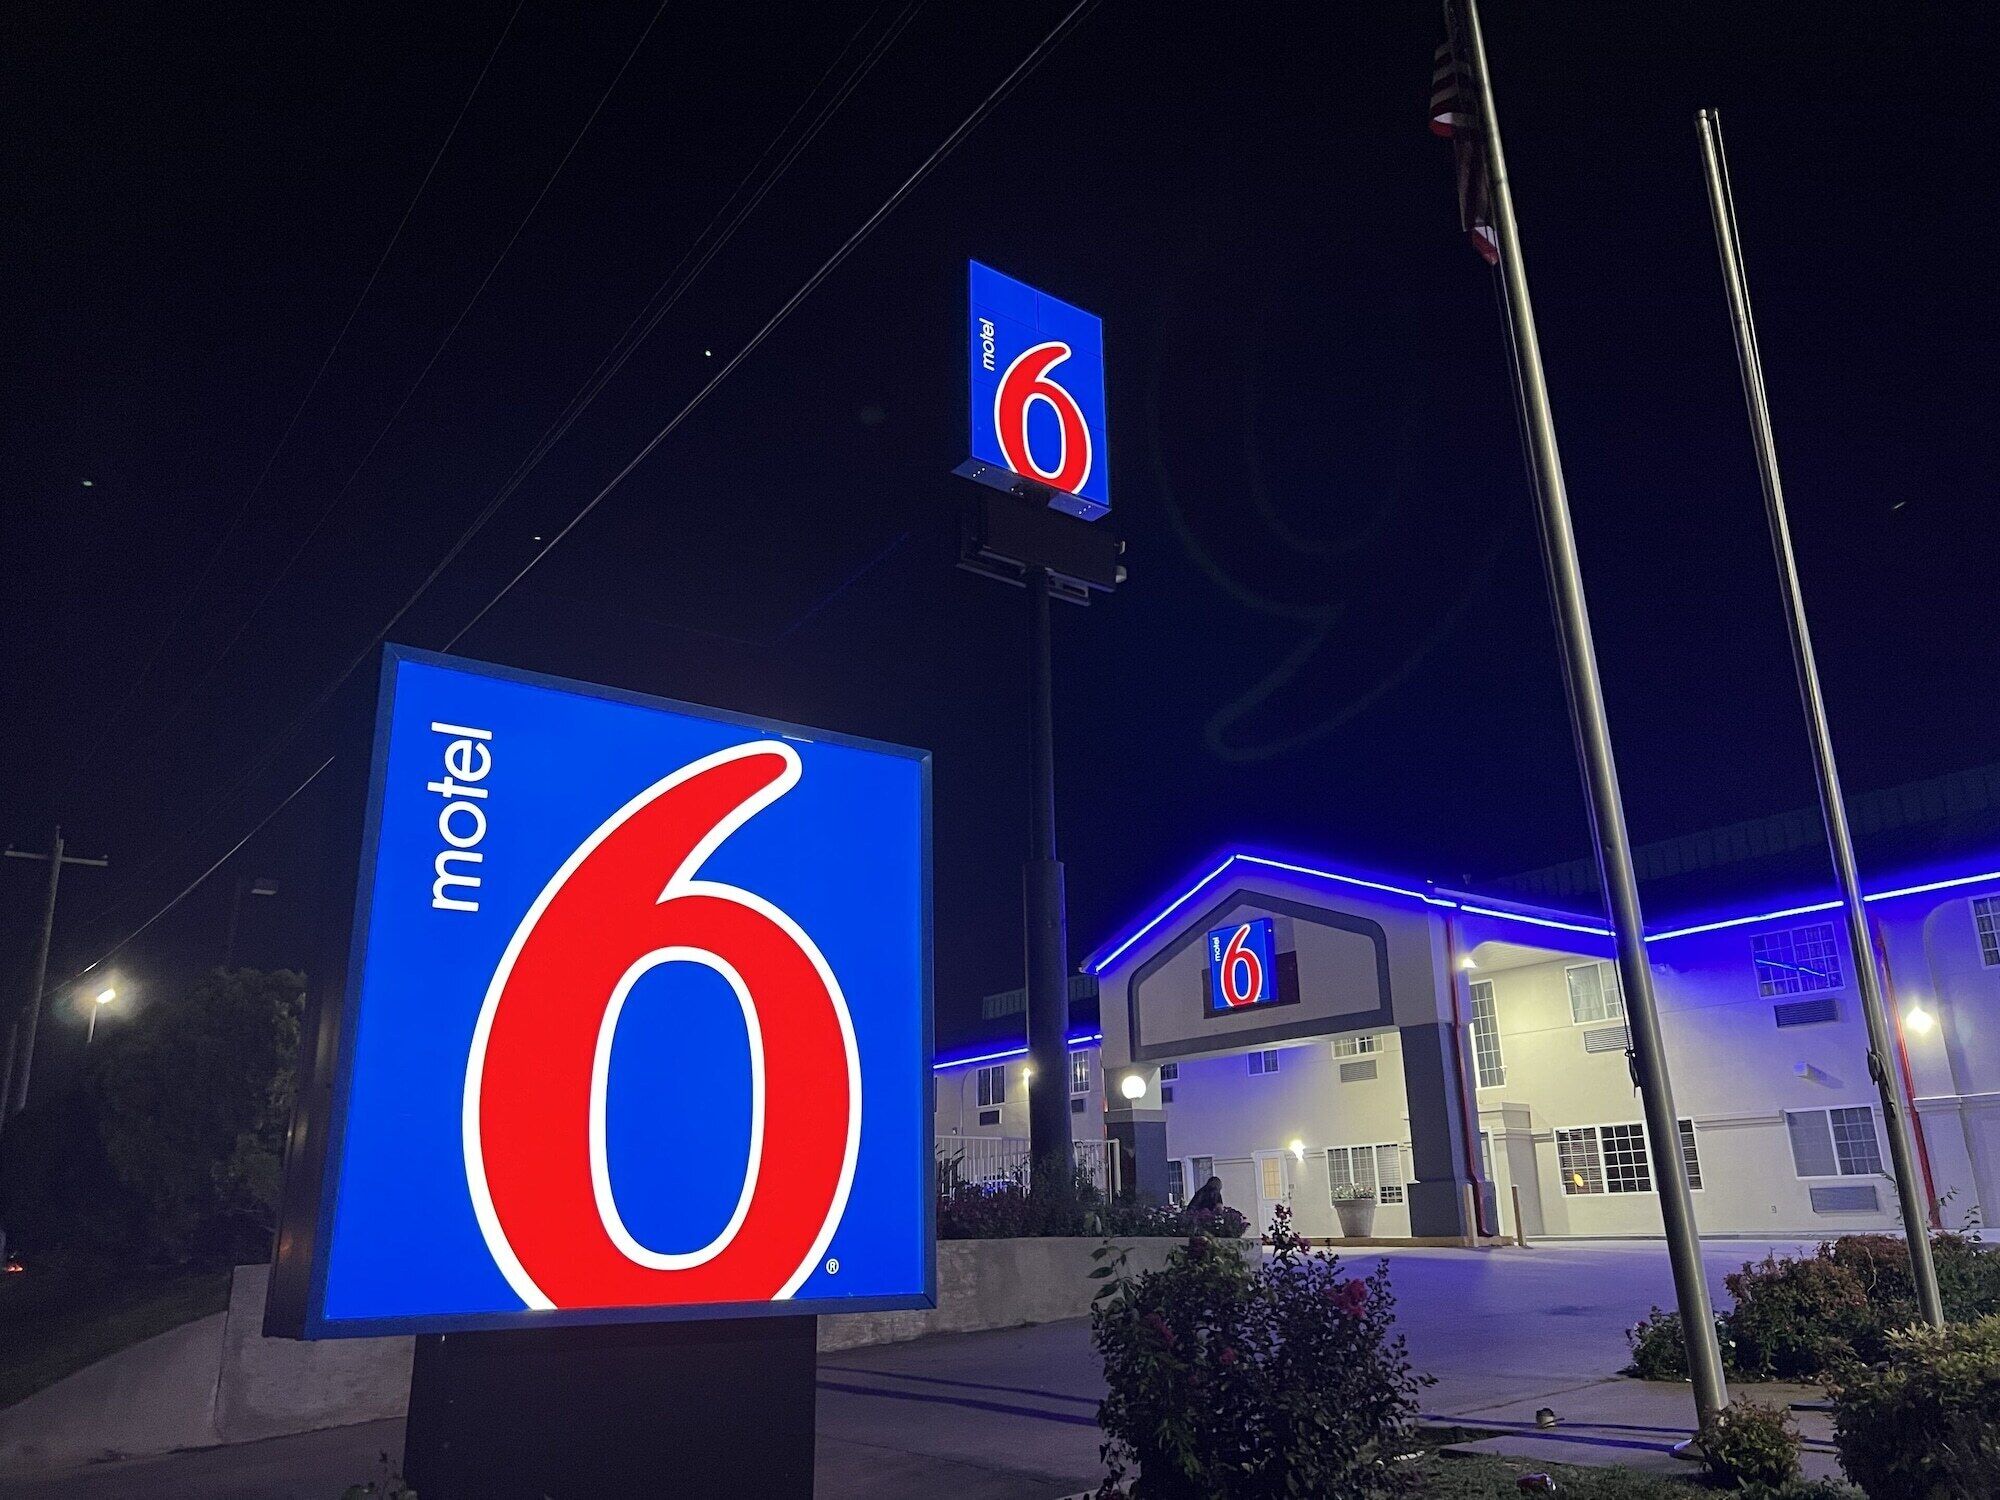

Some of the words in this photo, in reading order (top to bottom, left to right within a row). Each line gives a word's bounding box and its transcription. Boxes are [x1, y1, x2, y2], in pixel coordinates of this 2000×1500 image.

[978, 317, 995, 372] motel
[994, 341, 1093, 496] 6
[427, 721, 493, 912] motel
[1212, 936, 1221, 962] motel
[1220, 923, 1263, 1007] 6
[462, 739, 862, 1312] 6
